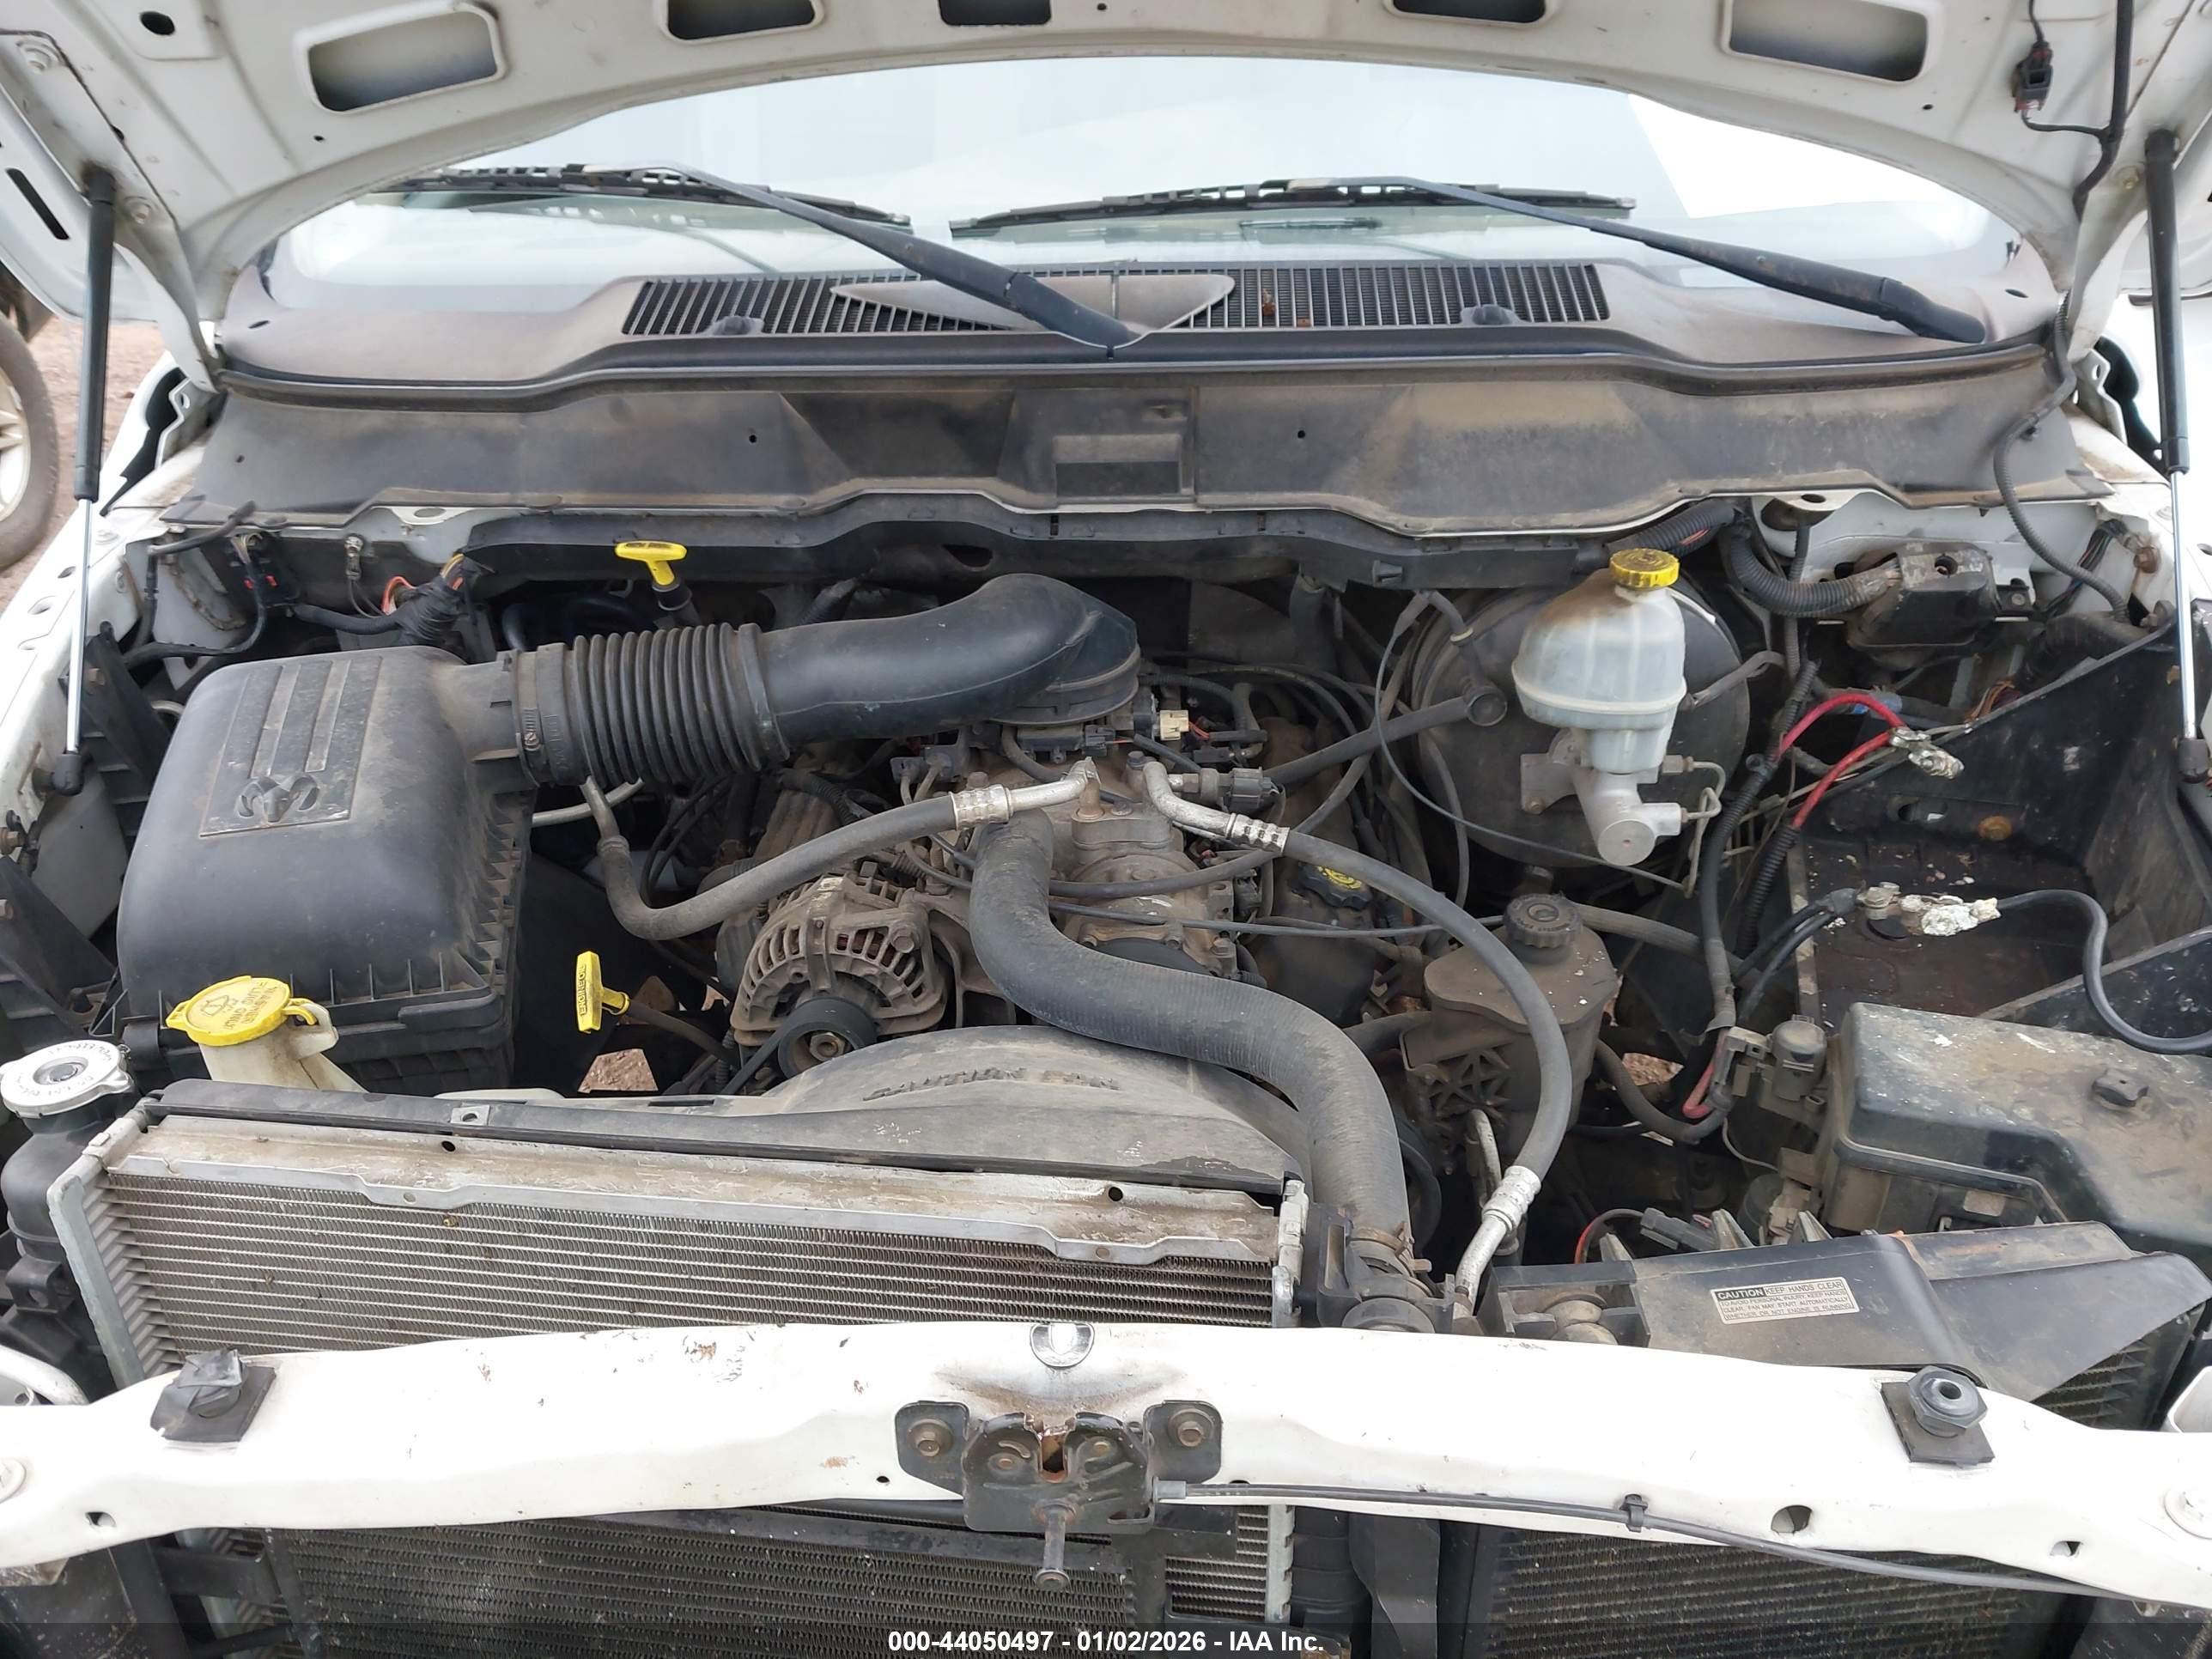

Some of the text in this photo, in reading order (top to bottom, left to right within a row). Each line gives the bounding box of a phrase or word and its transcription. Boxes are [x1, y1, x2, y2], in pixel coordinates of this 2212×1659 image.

[578, 981, 586, 1017] ENGINE
[1717, 1288, 1764, 1299] CAUTION
[1766, 1286, 1785, 1295] KEEP
[1818, 1281, 1843, 1290] CLEAR
[1799, 1297, 1849, 1305] AUTOMATICALLY
